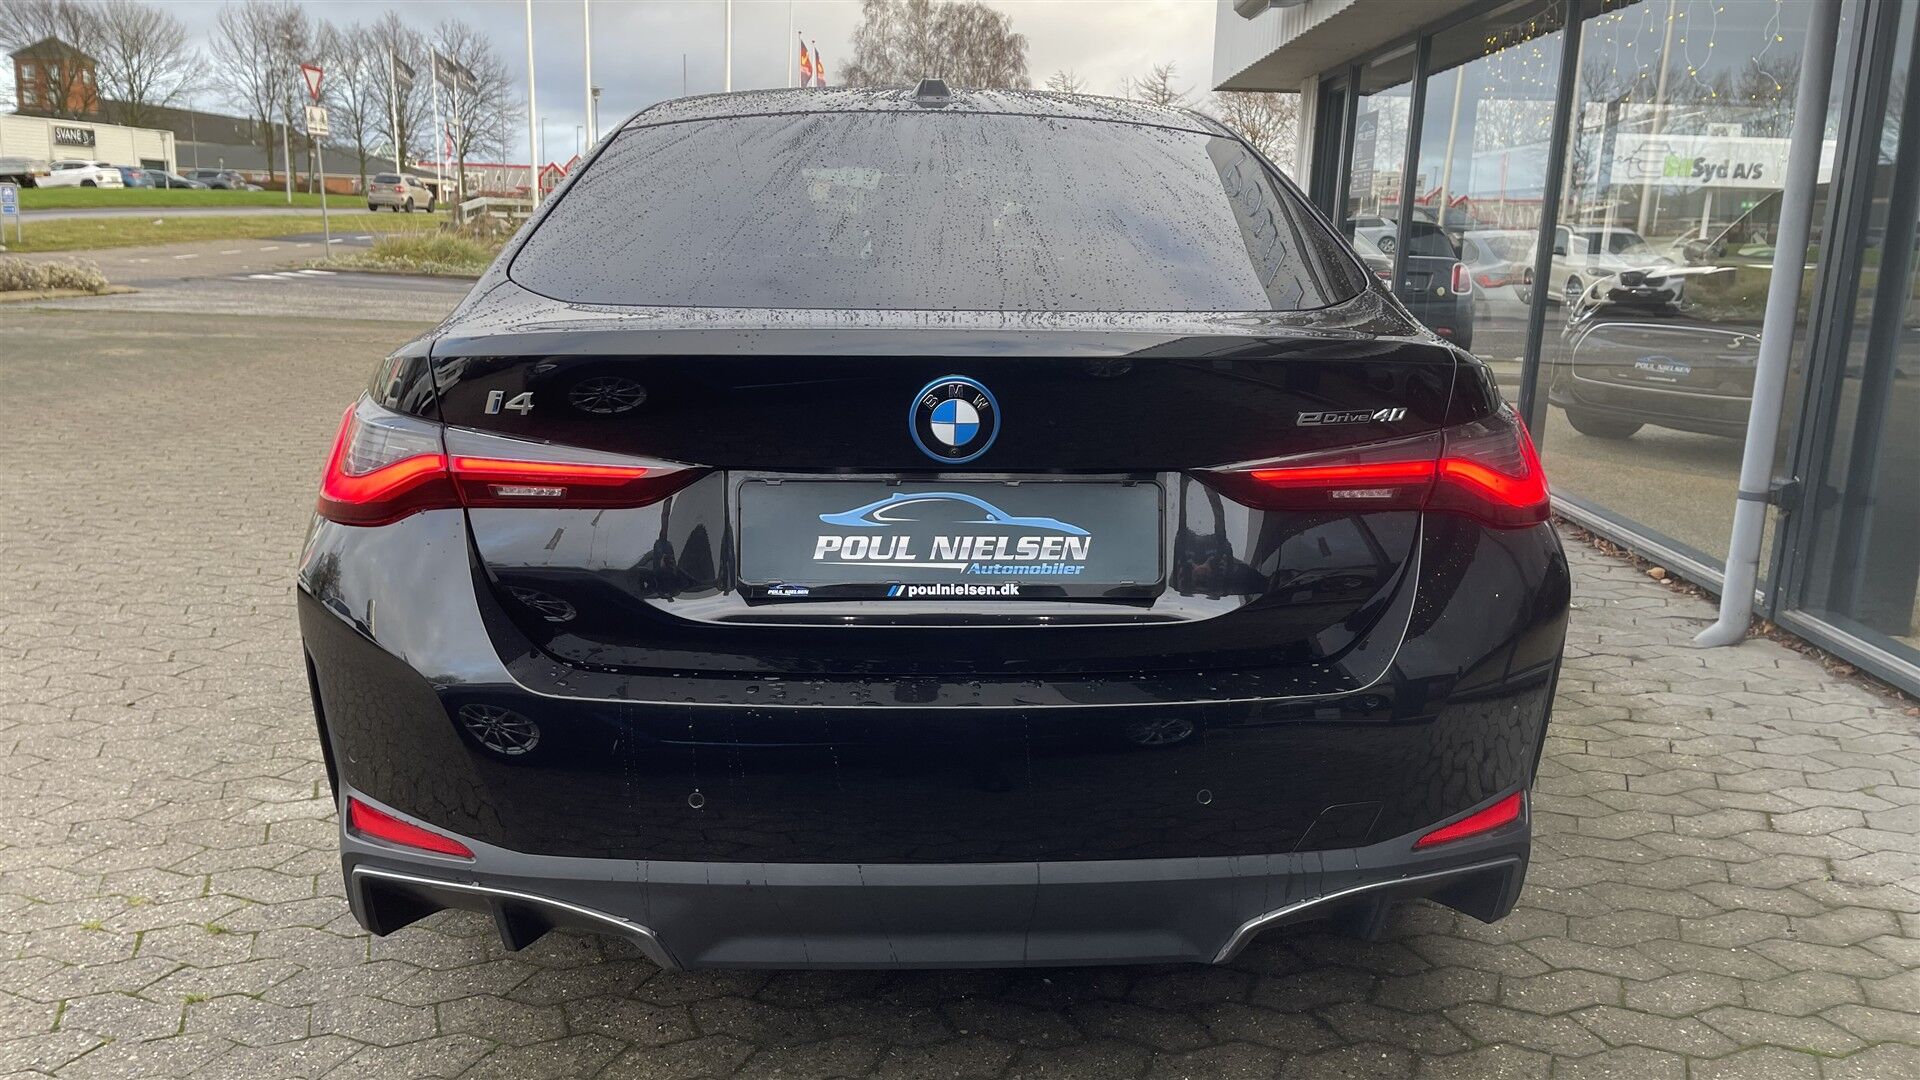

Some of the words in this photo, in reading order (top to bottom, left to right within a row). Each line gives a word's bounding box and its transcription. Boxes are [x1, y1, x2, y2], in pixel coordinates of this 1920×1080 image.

[1732, 163, 1764, 180] A/S
[484, 389, 535, 416] i4
[922, 384, 990, 411] BMW
[813, 535, 917, 560] POUL
[929, 536, 1091, 561] NIELSEN
[966, 562, 1085, 575] Automobiler
[907, 582, 1020, 597] poulnielsen.dk
